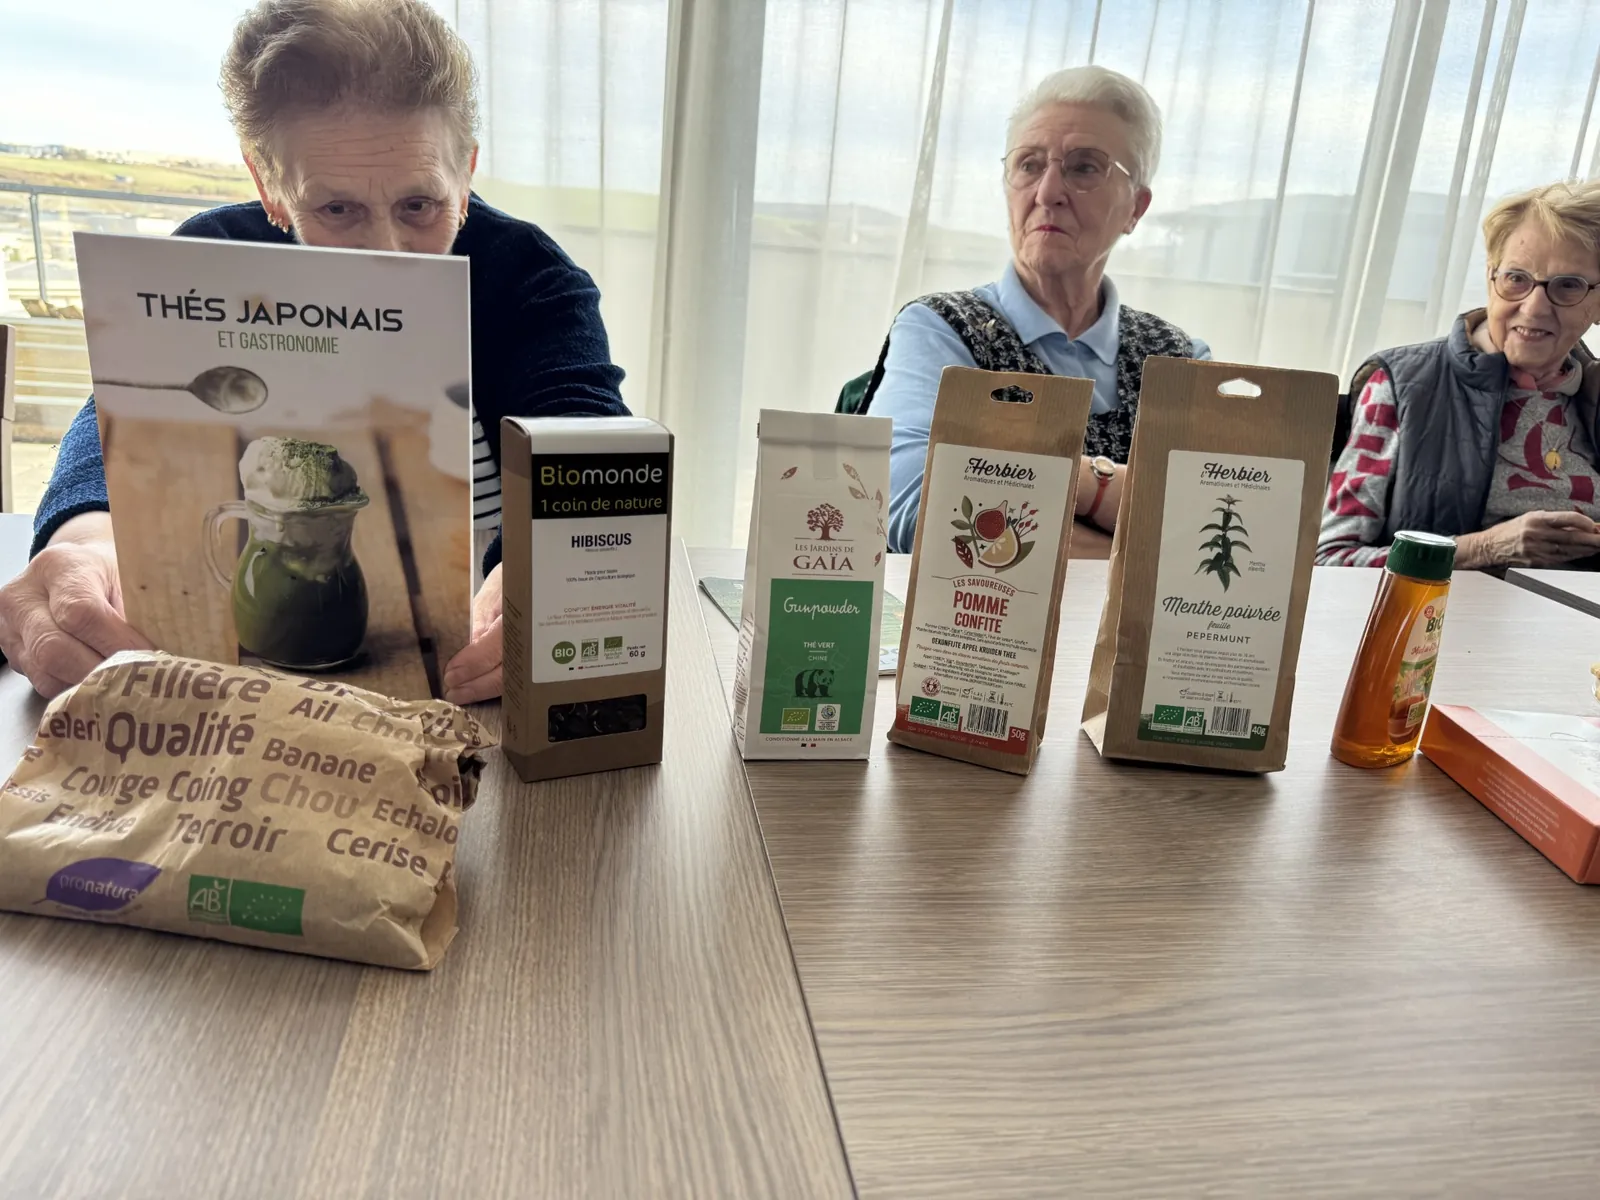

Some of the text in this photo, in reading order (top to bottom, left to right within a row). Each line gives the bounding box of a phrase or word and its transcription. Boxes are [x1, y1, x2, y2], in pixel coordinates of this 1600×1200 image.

[136, 289, 404, 333] THÉS JAPONAIS
[218, 331, 340, 355] ET GASTRONOMIE
[541, 464, 663, 486] Biomonde
[963, 474, 997, 485] Aromatiques
[541, 496, 663, 512] 1 coin de nature
[571, 532, 632, 548] HIBISCUS
[793, 553, 855, 571] GAÏA
[953, 579, 1016, 598] LES SAVOUREUSES
[783, 597, 861, 620] Gunpowder
[953, 590, 1010, 617] POMME
[1162, 596, 1282, 623] Menthe poivrée
[954, 612, 1003, 634] CONFITE
[1206, 620, 1232, 631] feuille
[803, 641, 817, 649] THÉ
[1186, 631, 1251, 644] PEPERMUNT
[555, 648, 574, 658] BIO
[629, 650, 646, 658] 60 g
[962, 641, 978, 652] APPEL
[1003, 649, 1017, 660] THEE
[121, 659, 272, 703] Filière
[288, 697, 339, 723] Ail
[942, 711, 957, 723] AB
[1185, 715, 1200, 727] AB
[105, 711, 257, 764] Qualité
[1011, 729, 1026, 741] 50g
[1251, 725, 1266, 737] 40g
[262, 737, 377, 784] Banane
[61, 766, 160, 805] Courge
[166, 766, 253, 813] Coing
[260, 772, 359, 820] Chou
[43, 803, 138, 834] Endive
[372, 798, 459, 845] Echalo
[169, 813, 288, 853] Terroir
[326, 828, 428, 877] Cerise
[59, 872, 140, 901] pronatura
[190, 884, 222, 912] AB
